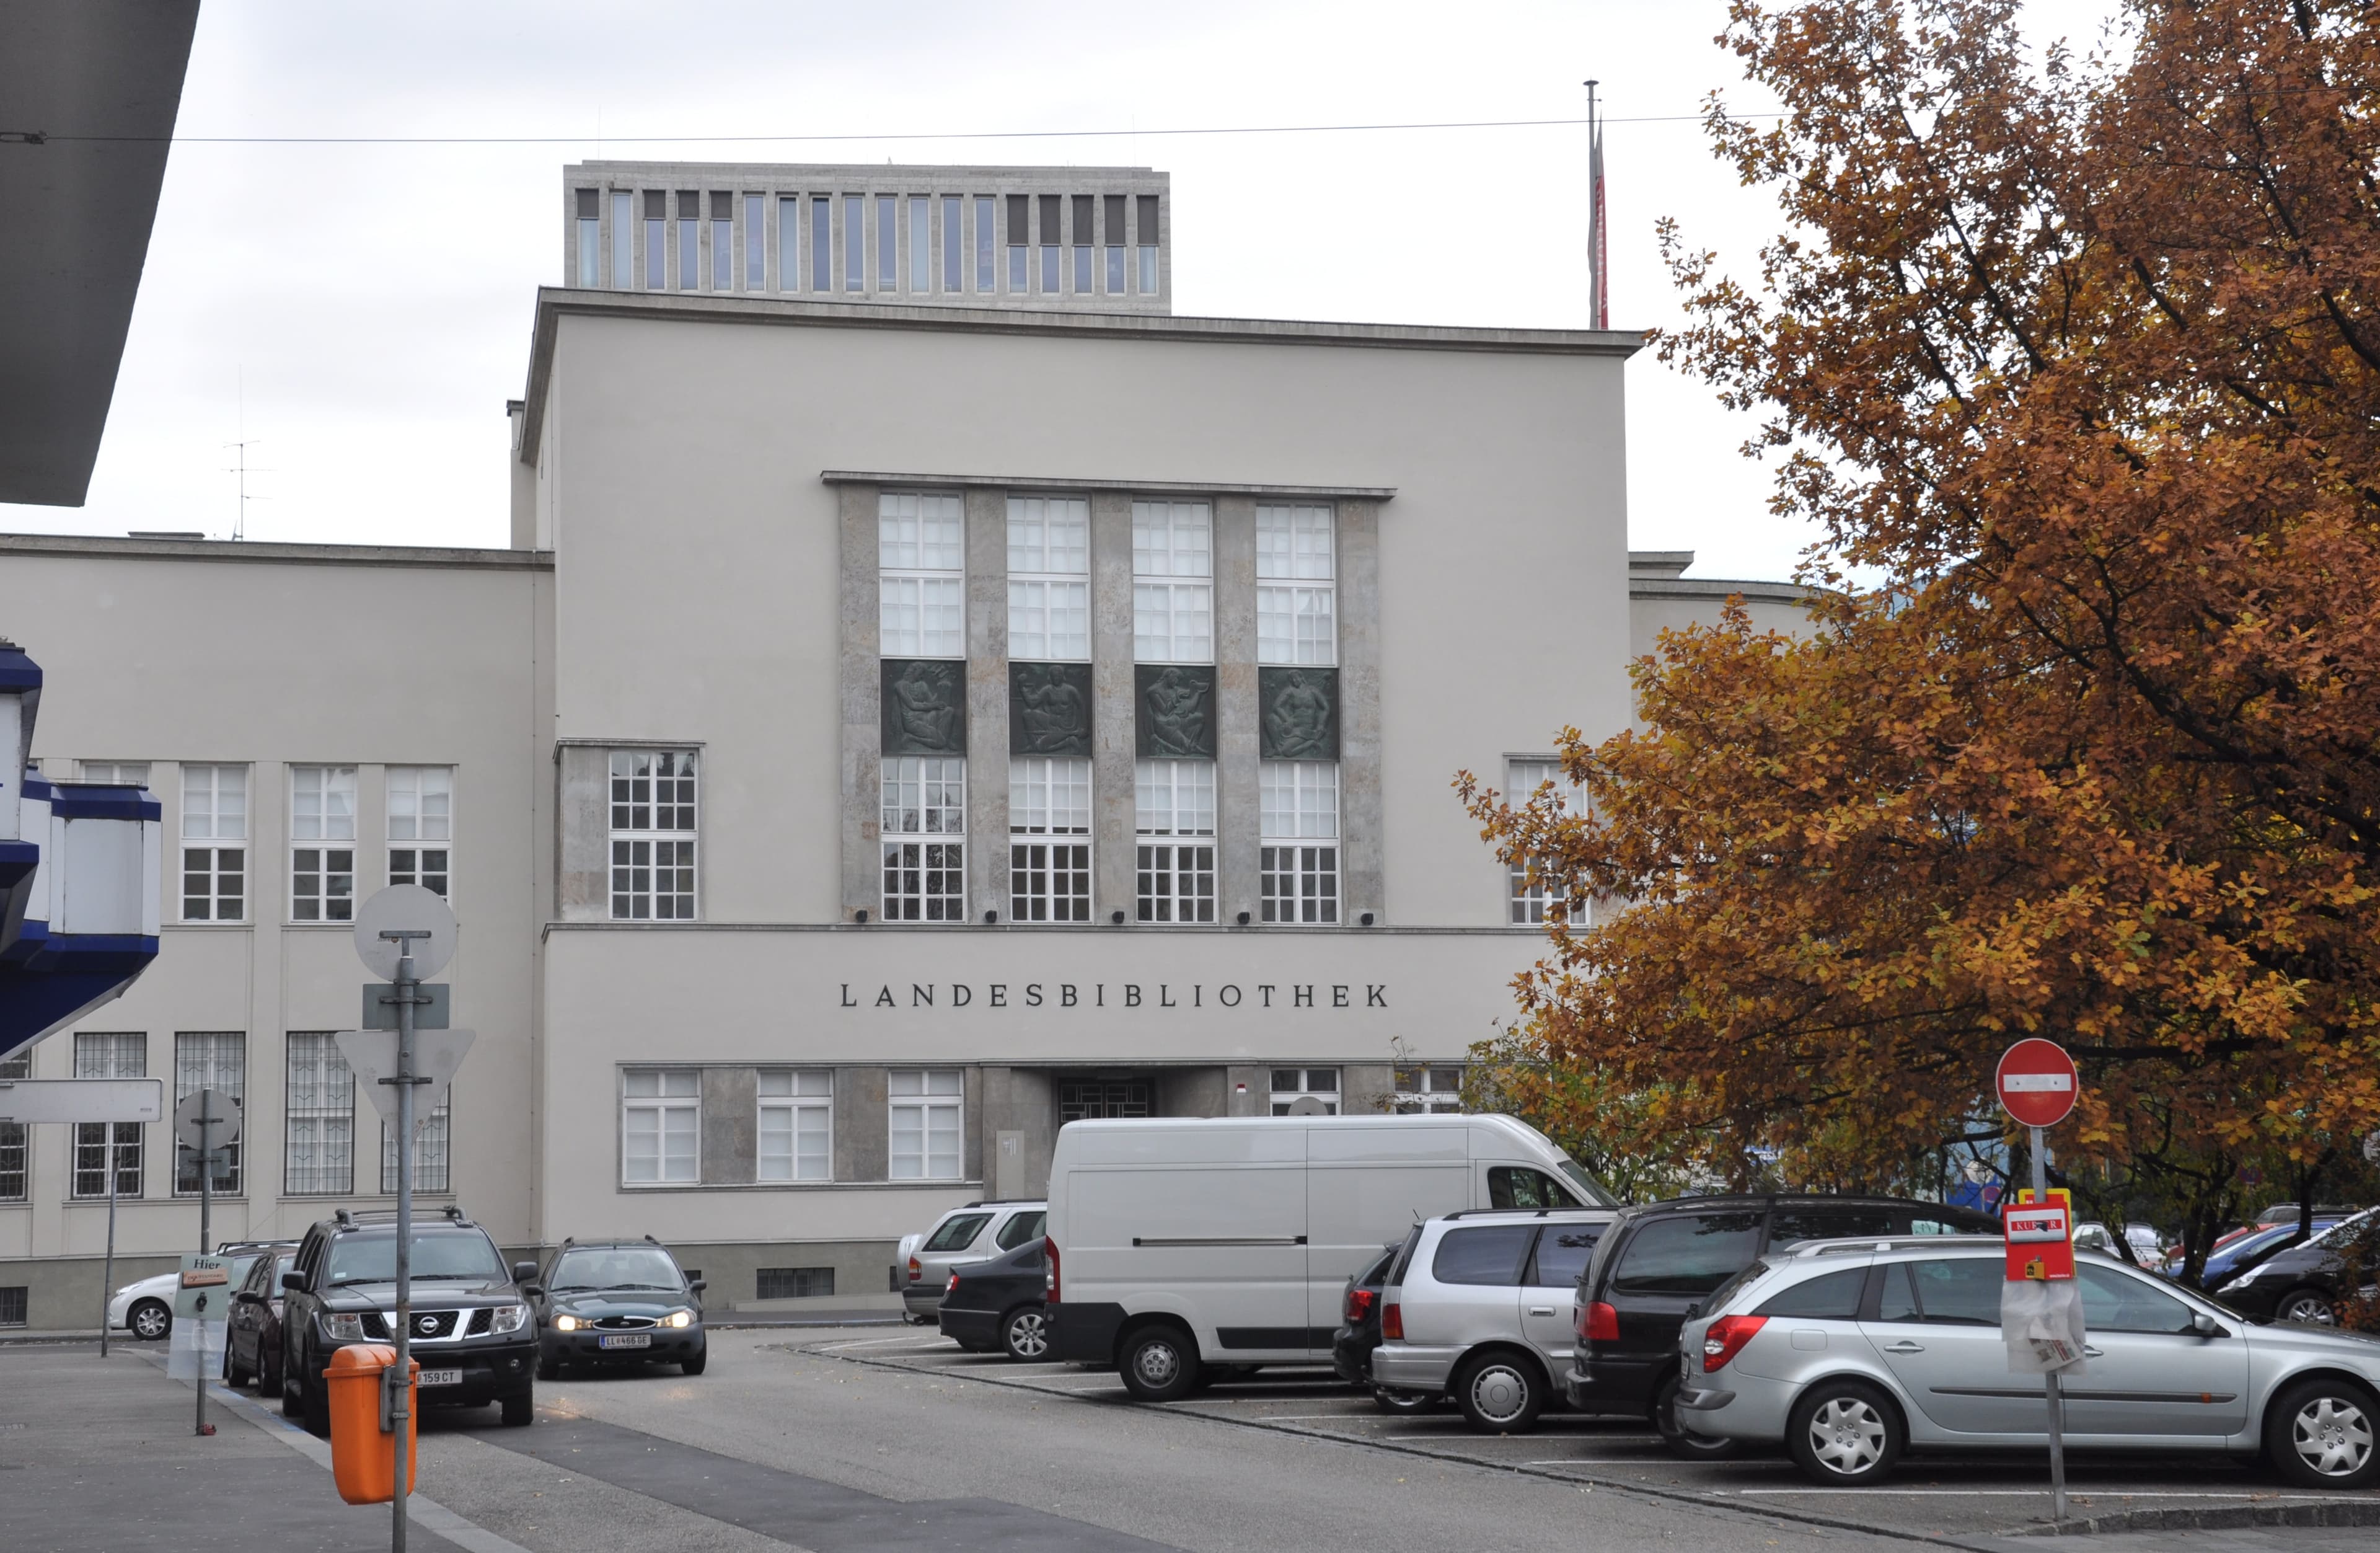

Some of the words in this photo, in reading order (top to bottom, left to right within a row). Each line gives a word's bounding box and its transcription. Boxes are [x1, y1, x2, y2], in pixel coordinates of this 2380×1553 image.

[841, 983, 1388, 1007] LANDESBIBLIOTHEK
[194, 1259, 221, 1270] Hier
[423, 1372, 440, 1383] 159
[442, 1372, 454, 1382] CT
